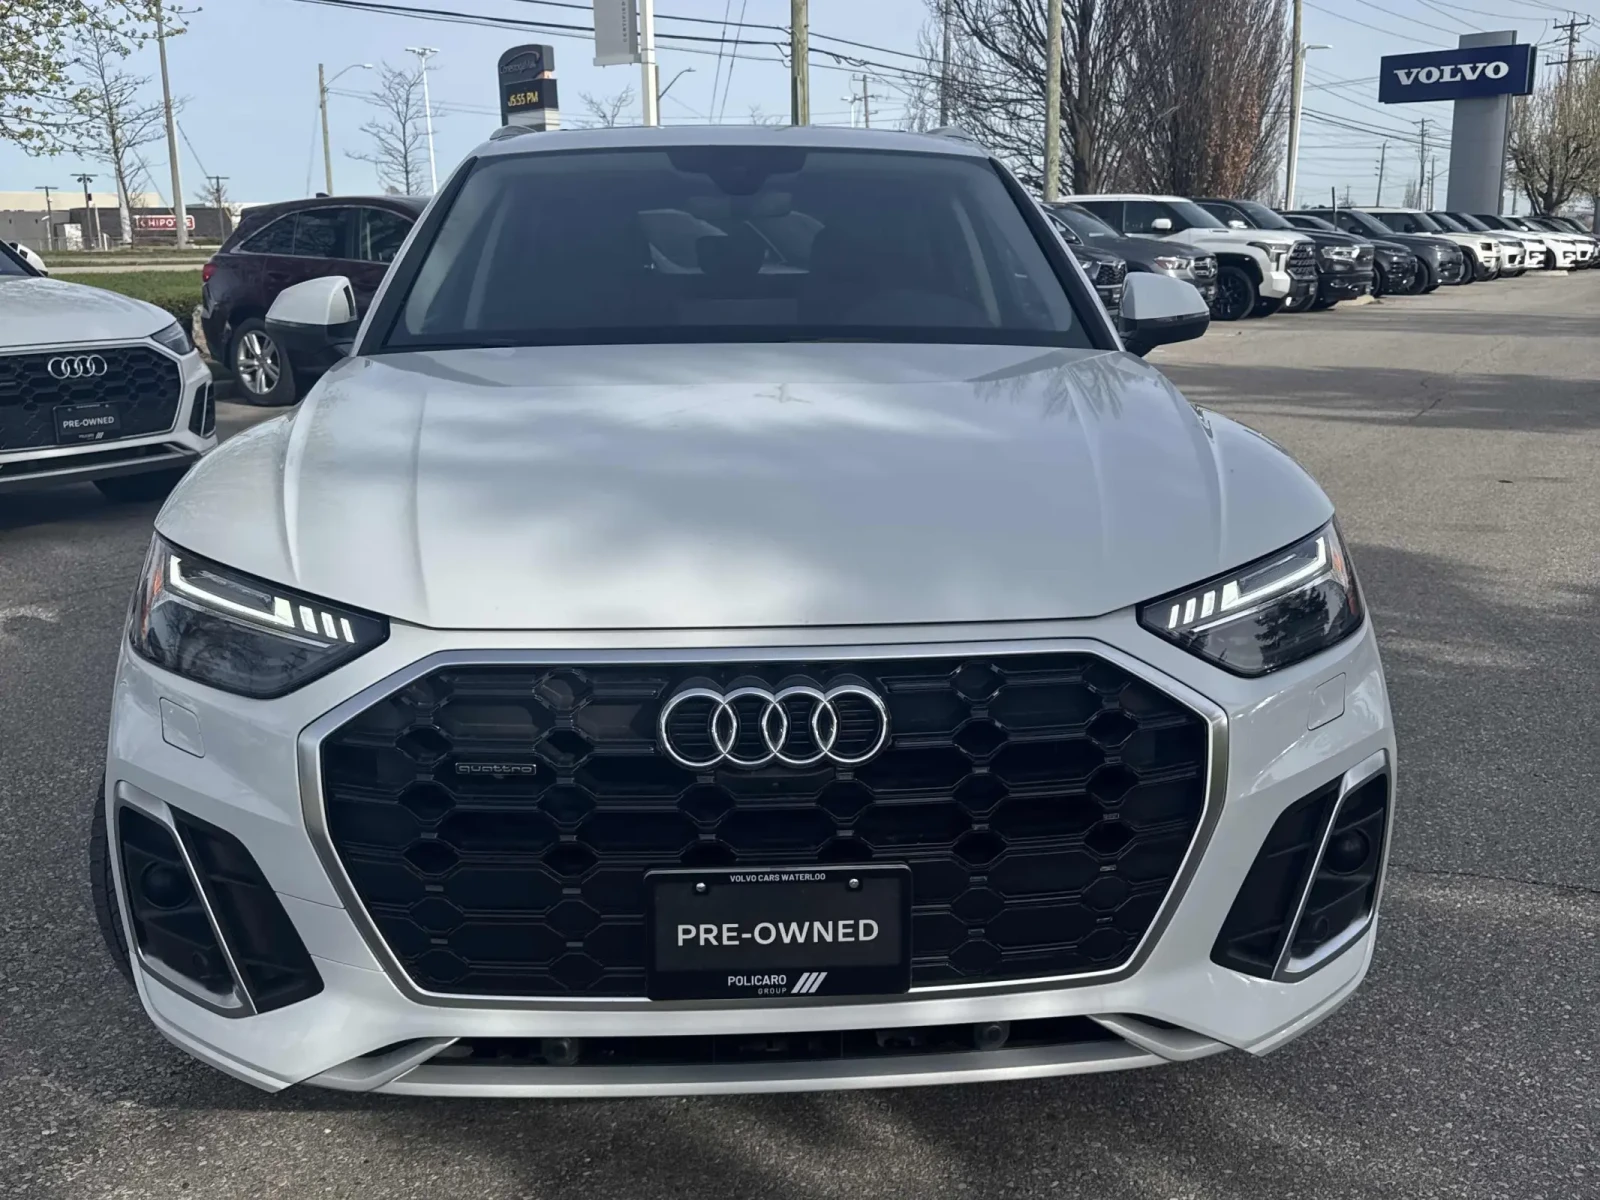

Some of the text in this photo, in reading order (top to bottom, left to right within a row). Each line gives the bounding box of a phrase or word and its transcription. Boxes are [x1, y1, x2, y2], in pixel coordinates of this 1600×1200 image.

[1394, 61, 1509, 86] VOLVO
[527, 91, 538, 104] PM
[140, 218, 192, 227] CHIPOE
[62, 415, 115, 428] PRE-OWNED
[458, 765, 532, 774] quattro
[729, 872, 826, 883] VOLVO CARS WATERLOO
[677, 919, 879, 946] PRE-OWNED
[727, 974, 787, 986] POLICARO
[757, 987, 787, 995] GROUP
